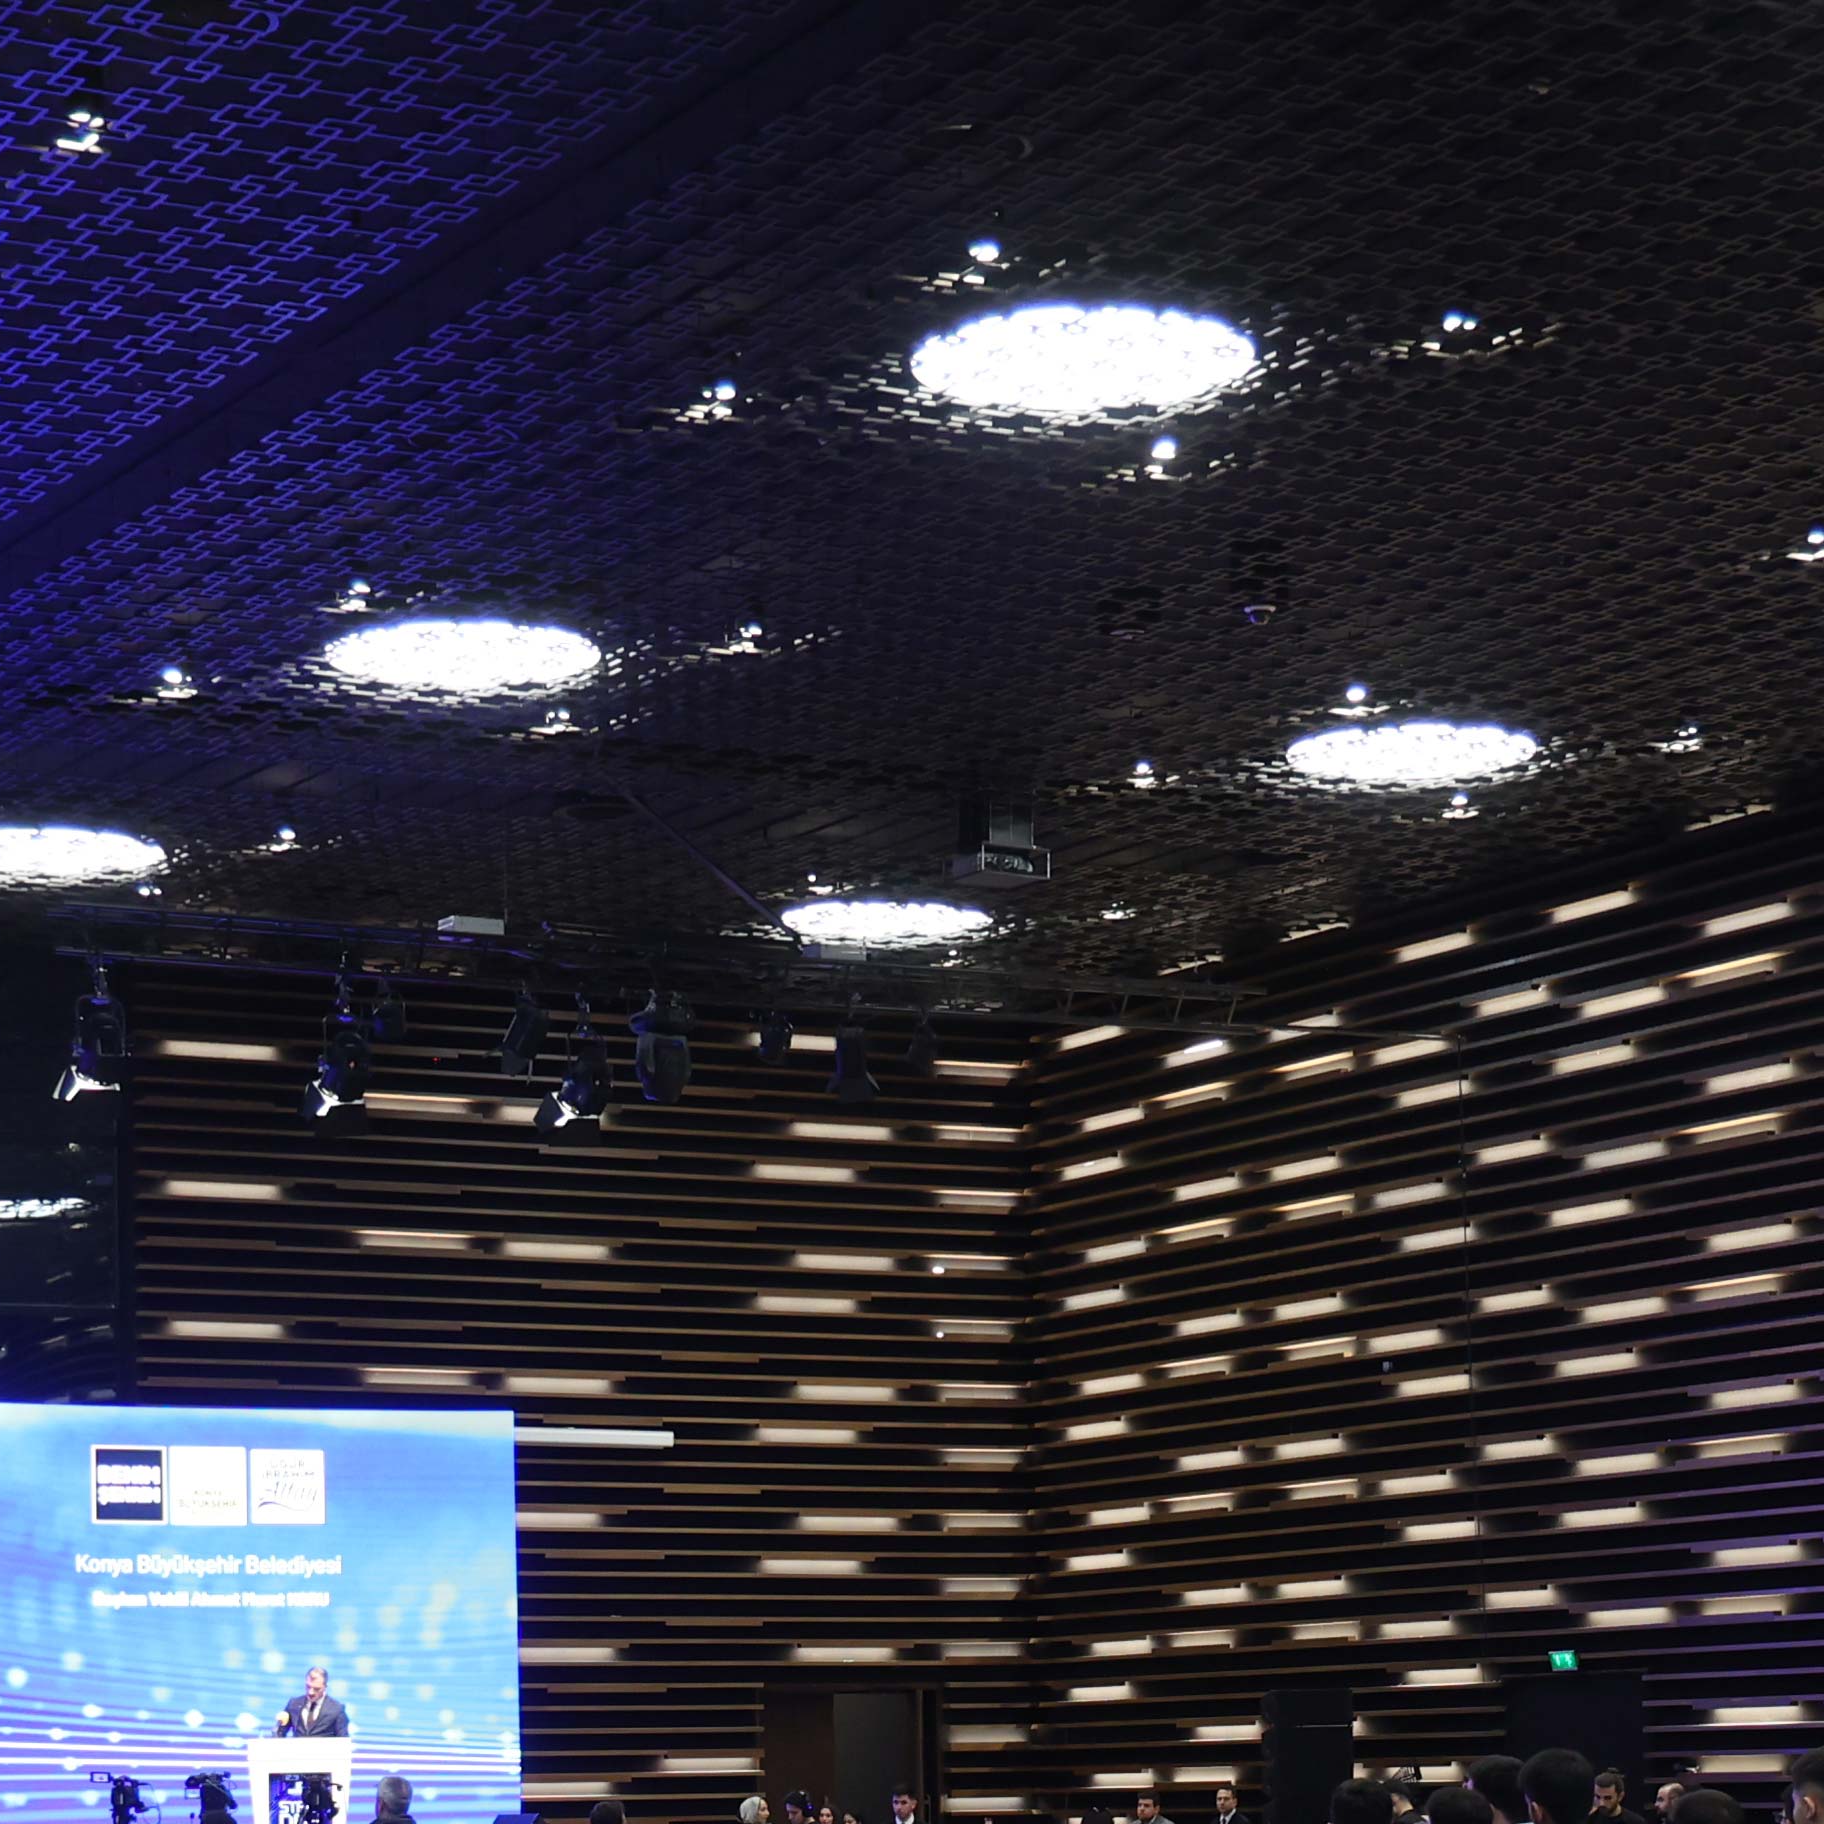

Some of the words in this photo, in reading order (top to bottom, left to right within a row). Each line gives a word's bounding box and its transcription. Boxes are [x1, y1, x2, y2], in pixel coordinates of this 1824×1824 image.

[75, 1553, 134, 1578] Konya
[136, 1553, 243, 1578] Büyükşehir
[245, 1554, 342, 1578] Belediyesi
